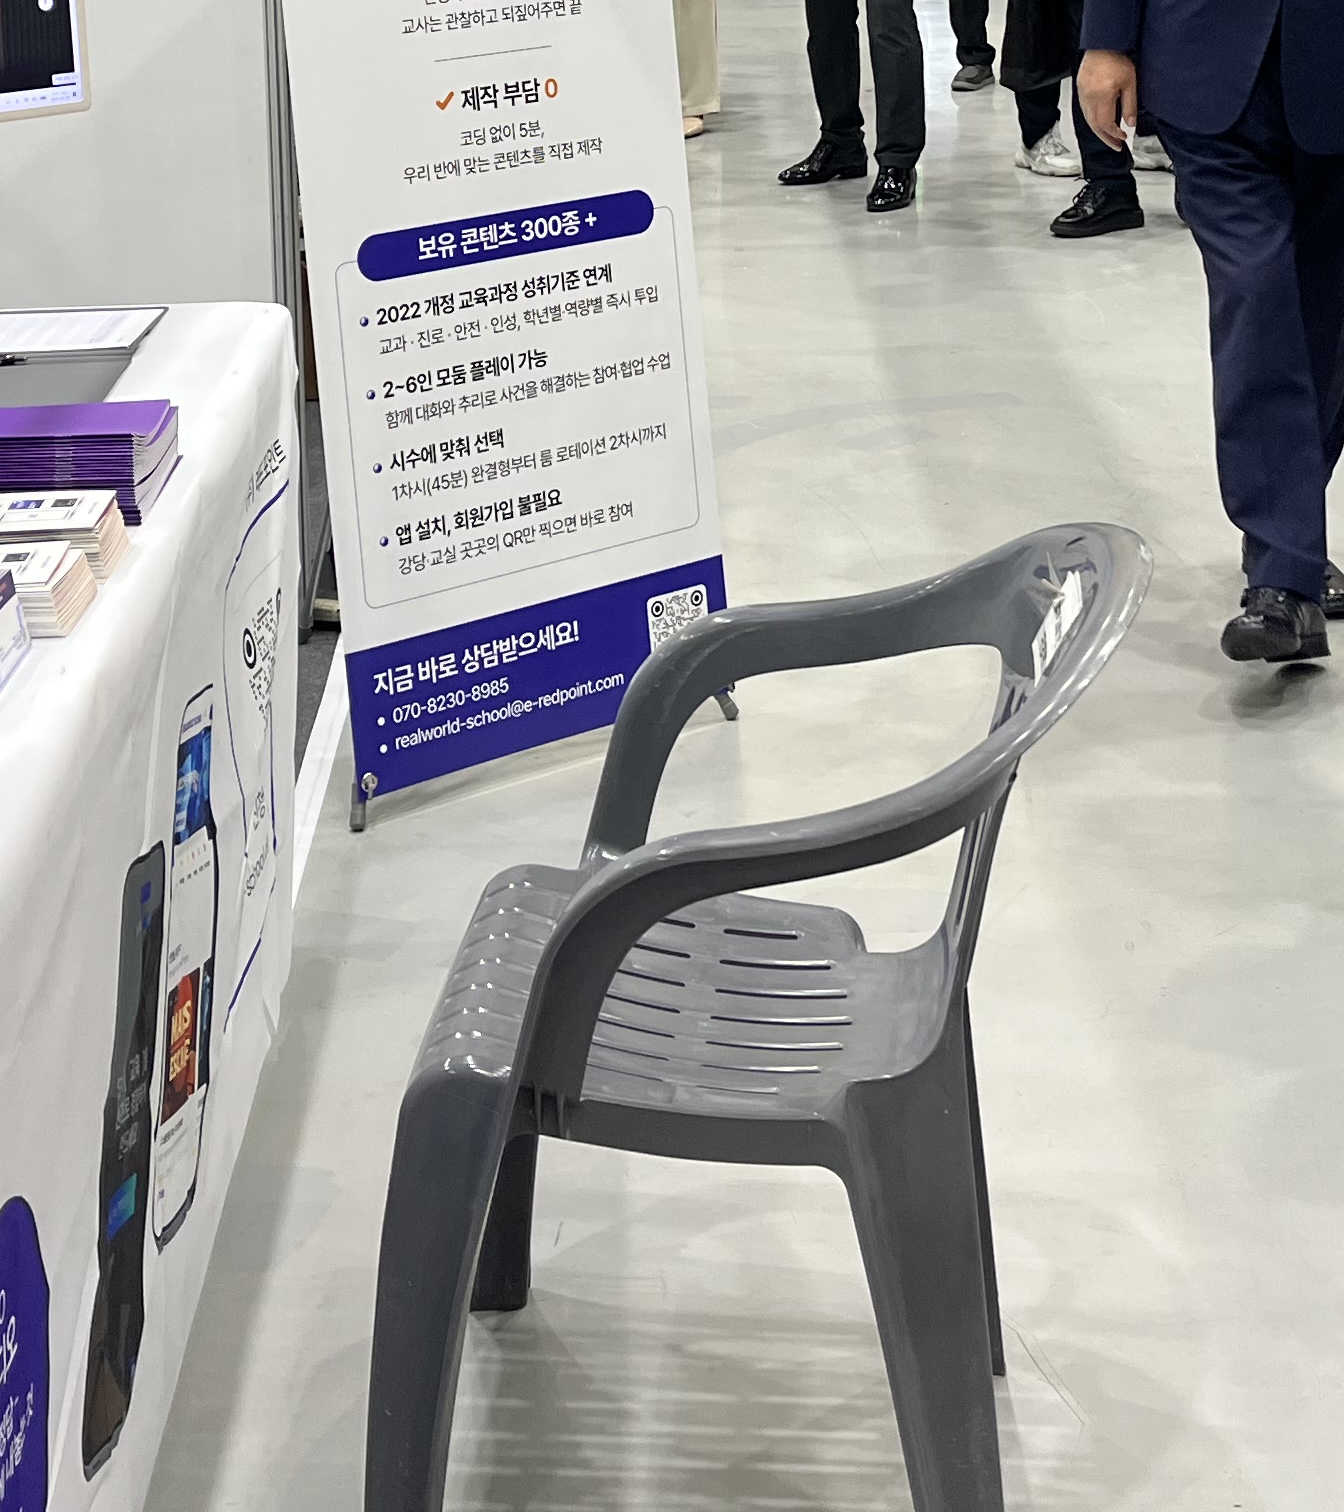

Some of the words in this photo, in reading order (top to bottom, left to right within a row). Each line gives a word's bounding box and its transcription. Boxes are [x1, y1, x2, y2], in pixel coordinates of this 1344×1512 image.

[401, 14, 442, 35] 교사는
[445, 8, 499, 31] 관찰하고
[501, 1, 567, 23] 되짚어주면
[460, 84, 499, 111] 제작
[503, 78, 541, 106] 부담
[544, 78, 558, 98] 0
[459, 126, 487, 147] 코딩
[489, 123, 516, 143] 없이
[519, 119, 545, 140] 5분,
[403, 163, 431, 185] 우리
[433, 158, 461, 180] 반에
[463, 154, 491, 175] 맞는
[492, 145, 546, 170] 콘텐츠를
[548, 142, 574, 162] 직접
[576, 136, 603, 157] 제작
[418, 231, 457, 261] 보유
[460, 223, 518, 255] 콘텐츠
[521, 210, 581, 242] 300종
[376, 302, 422, 327] 2022
[424, 293, 456, 318] 개정
[458, 282, 519, 311] 교육과정
[521, 271, 581, 300] 성취기준
[582, 262, 613, 286] 연계
[379, 333, 407, 356] 교과
[416, 327, 445, 349] 진로
[454, 319, 481, 342] 안전
[490, 311, 521, 335] 인성,
[605, 288, 632, 310] 즉시
[634, 284, 659, 306] 투입
[382, 369, 433, 399] 2~6인
[436, 363, 467, 389] 모둠
[469, 354, 515, 383] 플레이
[518, 348, 549, 374] 가능
[385, 408, 413, 430] 함께
[416, 400, 456, 423] 대화와
[458, 392, 497, 414] 추리로
[500, 381, 538, 405] 사건을
[540, 369, 591, 394] 해결하는
[647, 350, 671, 373] 수업
[389, 443, 437, 472] 시수에
[439, 436, 471, 462] 맞춰
[473, 428, 505, 453] 선택
[391, 470, 468, 502] 1차시(45분)
[471, 450, 537, 483] 완결형부터
[539, 448, 553, 467] 룸
[556, 435, 606, 463] 로테이션
[609, 422, 668, 452] 2차시까지
[395, 524, 412, 546] 앱
[415, 516, 451, 541] 설치,
[453, 498, 515, 532] 회원가입
[517, 487, 563, 516] 불필요
[459, 533, 500, 557] 곳곳의
[502, 526, 537, 549] QR만
[538, 515, 577, 538] 찍으면
[579, 508, 607, 528] 바로
[608, 501, 634, 523] 참여
[373, 663, 414, 696] 지금
[418, 651, 458, 685] 바로
[461, 619, 580, 674] 상담받으세요!
[393, 676, 509, 724] 070-8230-8985
[394, 671, 625, 751] realworld-school@e-redpoint.com
